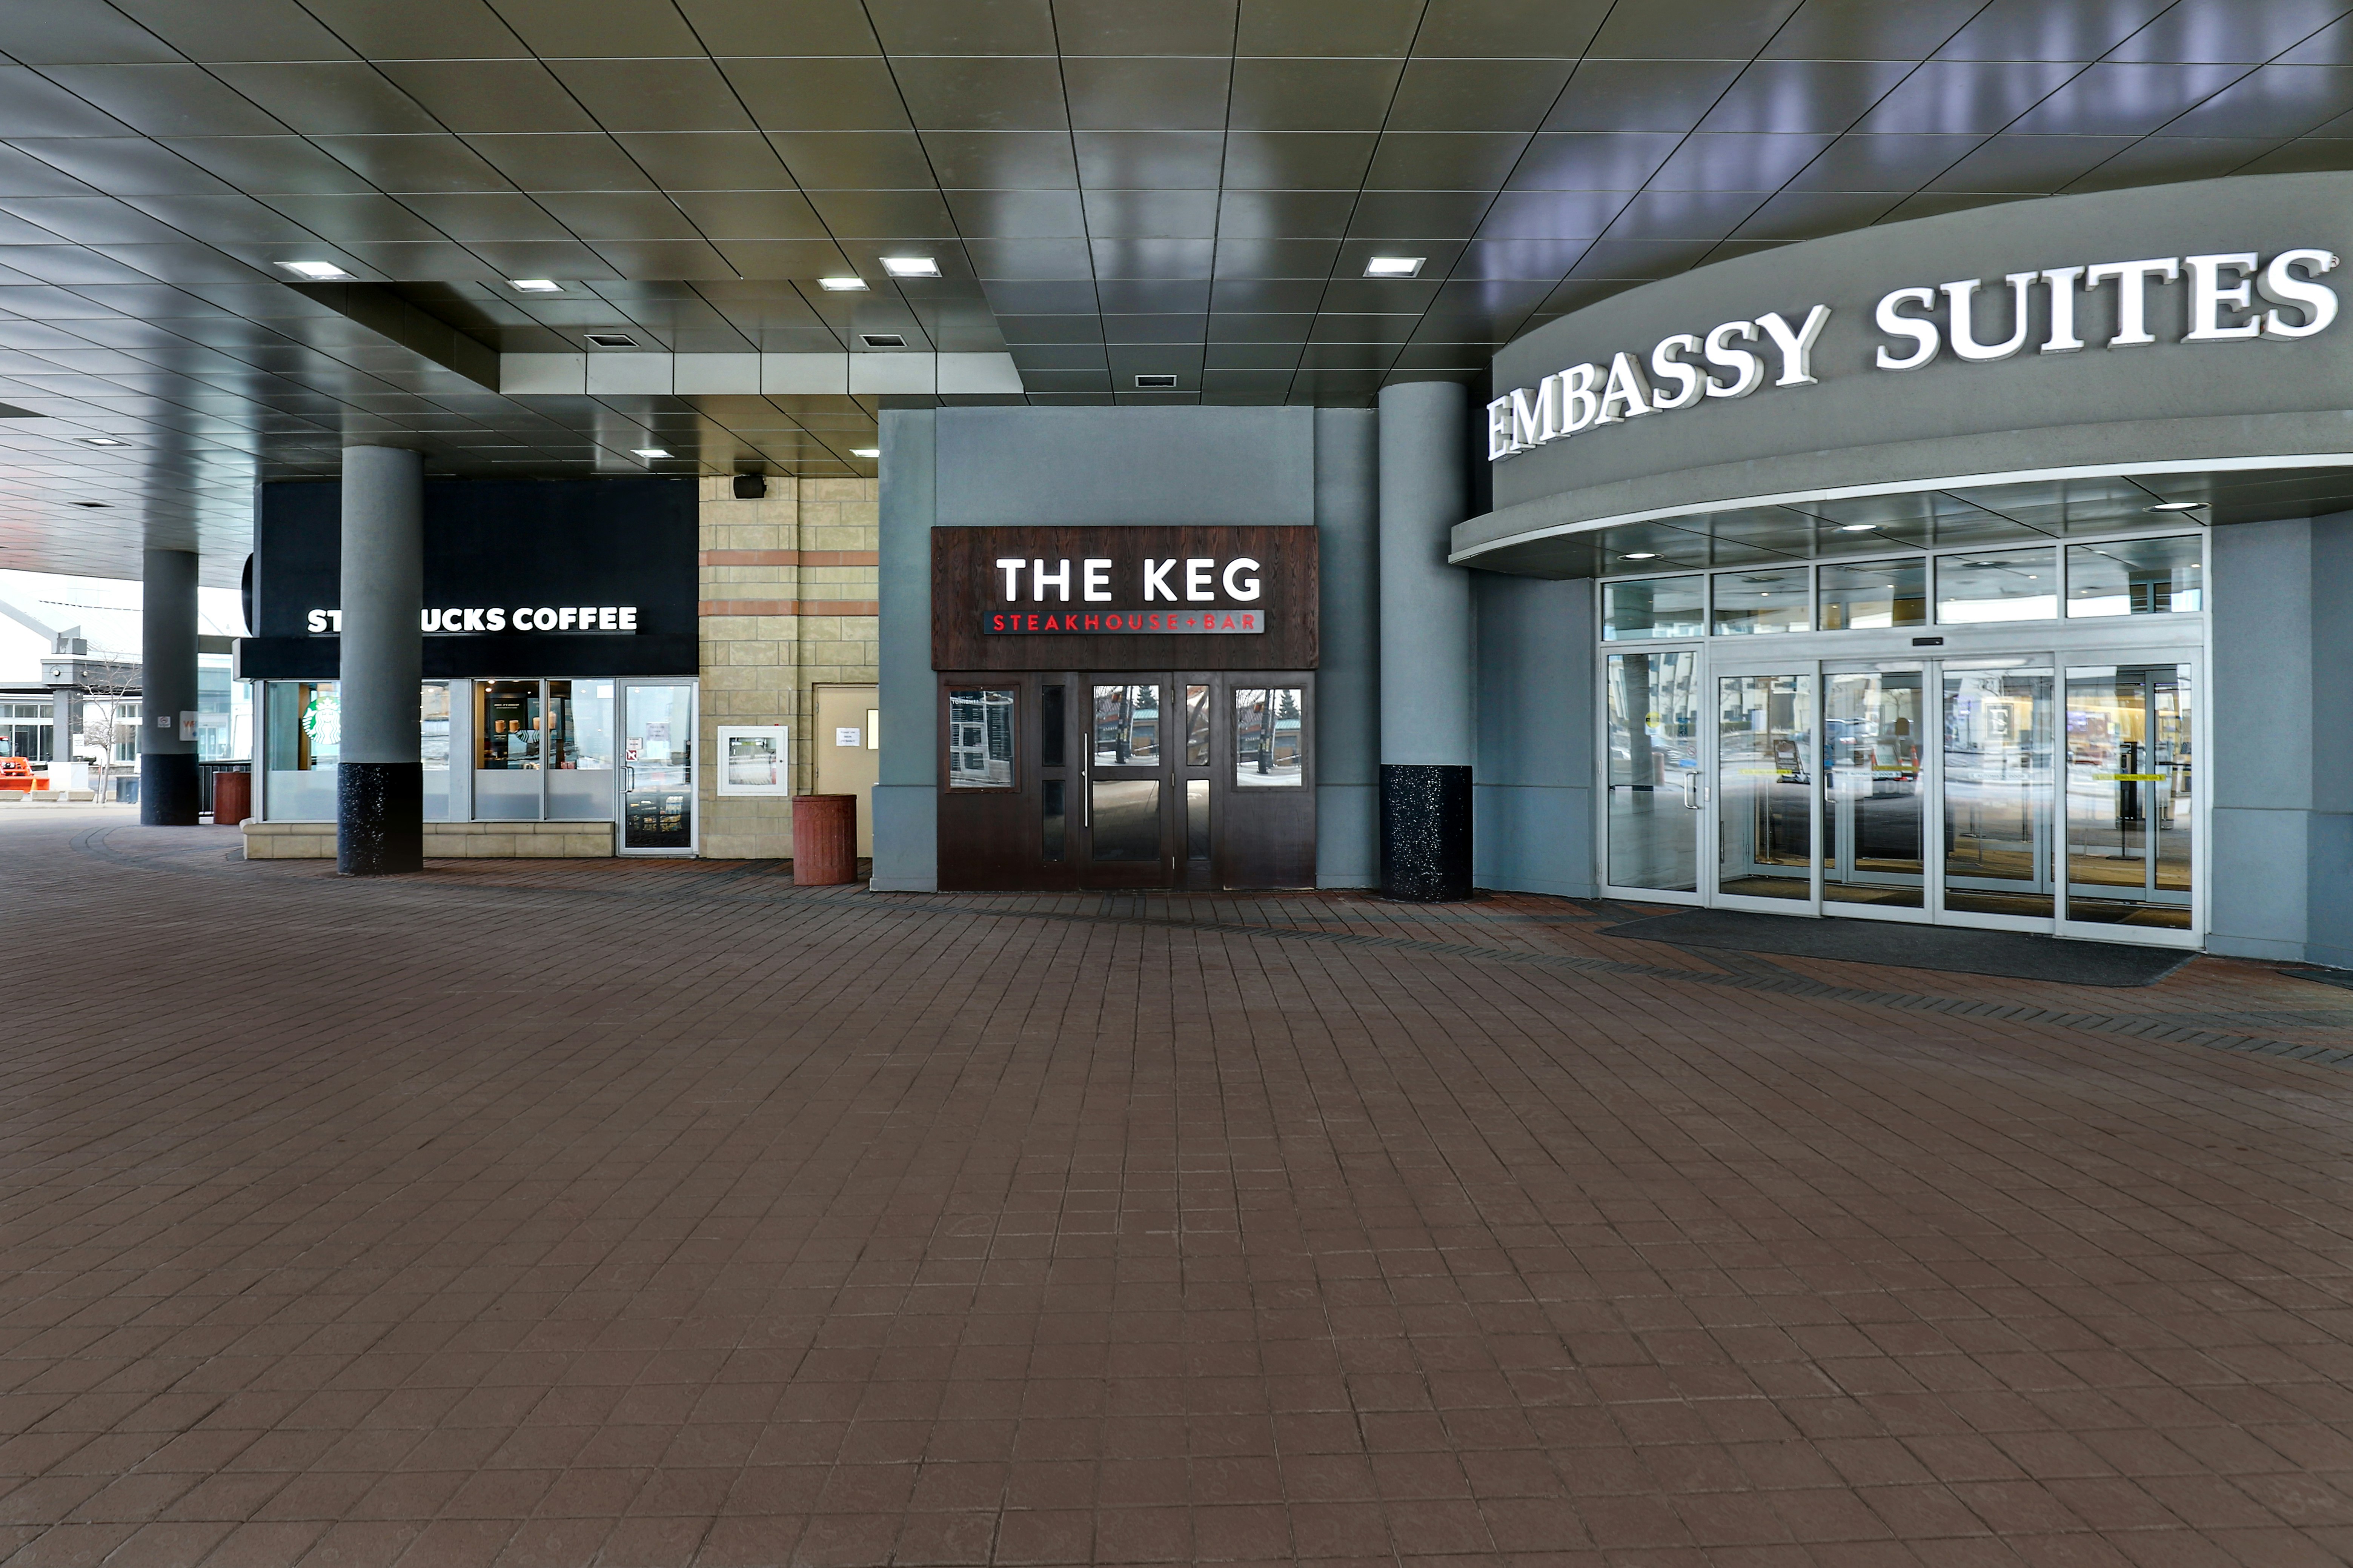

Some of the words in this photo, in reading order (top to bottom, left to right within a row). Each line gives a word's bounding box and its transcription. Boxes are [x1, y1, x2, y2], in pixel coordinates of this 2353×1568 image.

[1486, 304, 1832, 461] EMBASSY
[1875, 248, 2339, 371] SUITES
[996, 558, 1112, 602] THE
[1144, 557, 1260, 602] KEG
[307, 608, 506, 632] STUCKS
[512, 607, 637, 631] COFFEE
